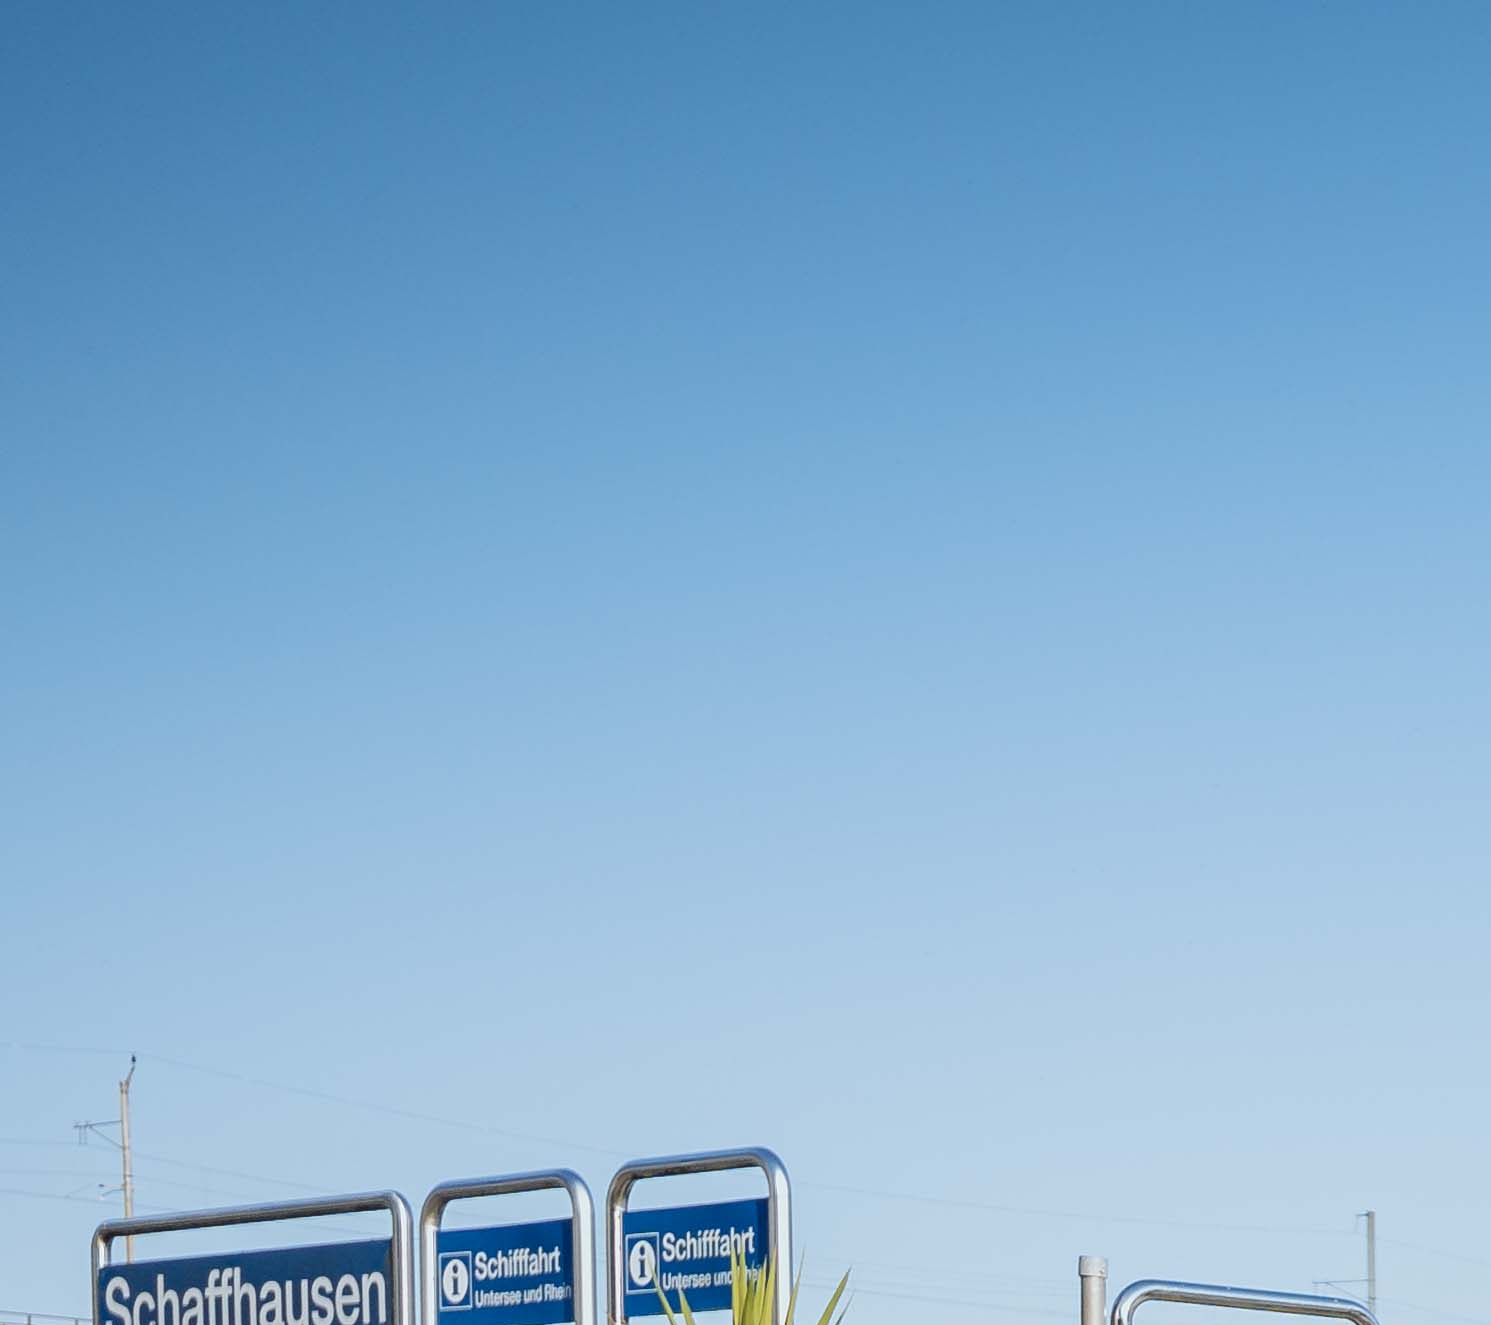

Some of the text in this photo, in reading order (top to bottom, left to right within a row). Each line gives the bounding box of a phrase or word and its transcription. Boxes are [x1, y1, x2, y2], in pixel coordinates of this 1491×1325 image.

[663, 1226, 755, 1262] Schifffahrt
[475, 1246, 560, 1280] Schifffahrt
[475, 1283, 571, 1308] Untersee und Rhein
[663, 1272, 711, 1290] Untersee
